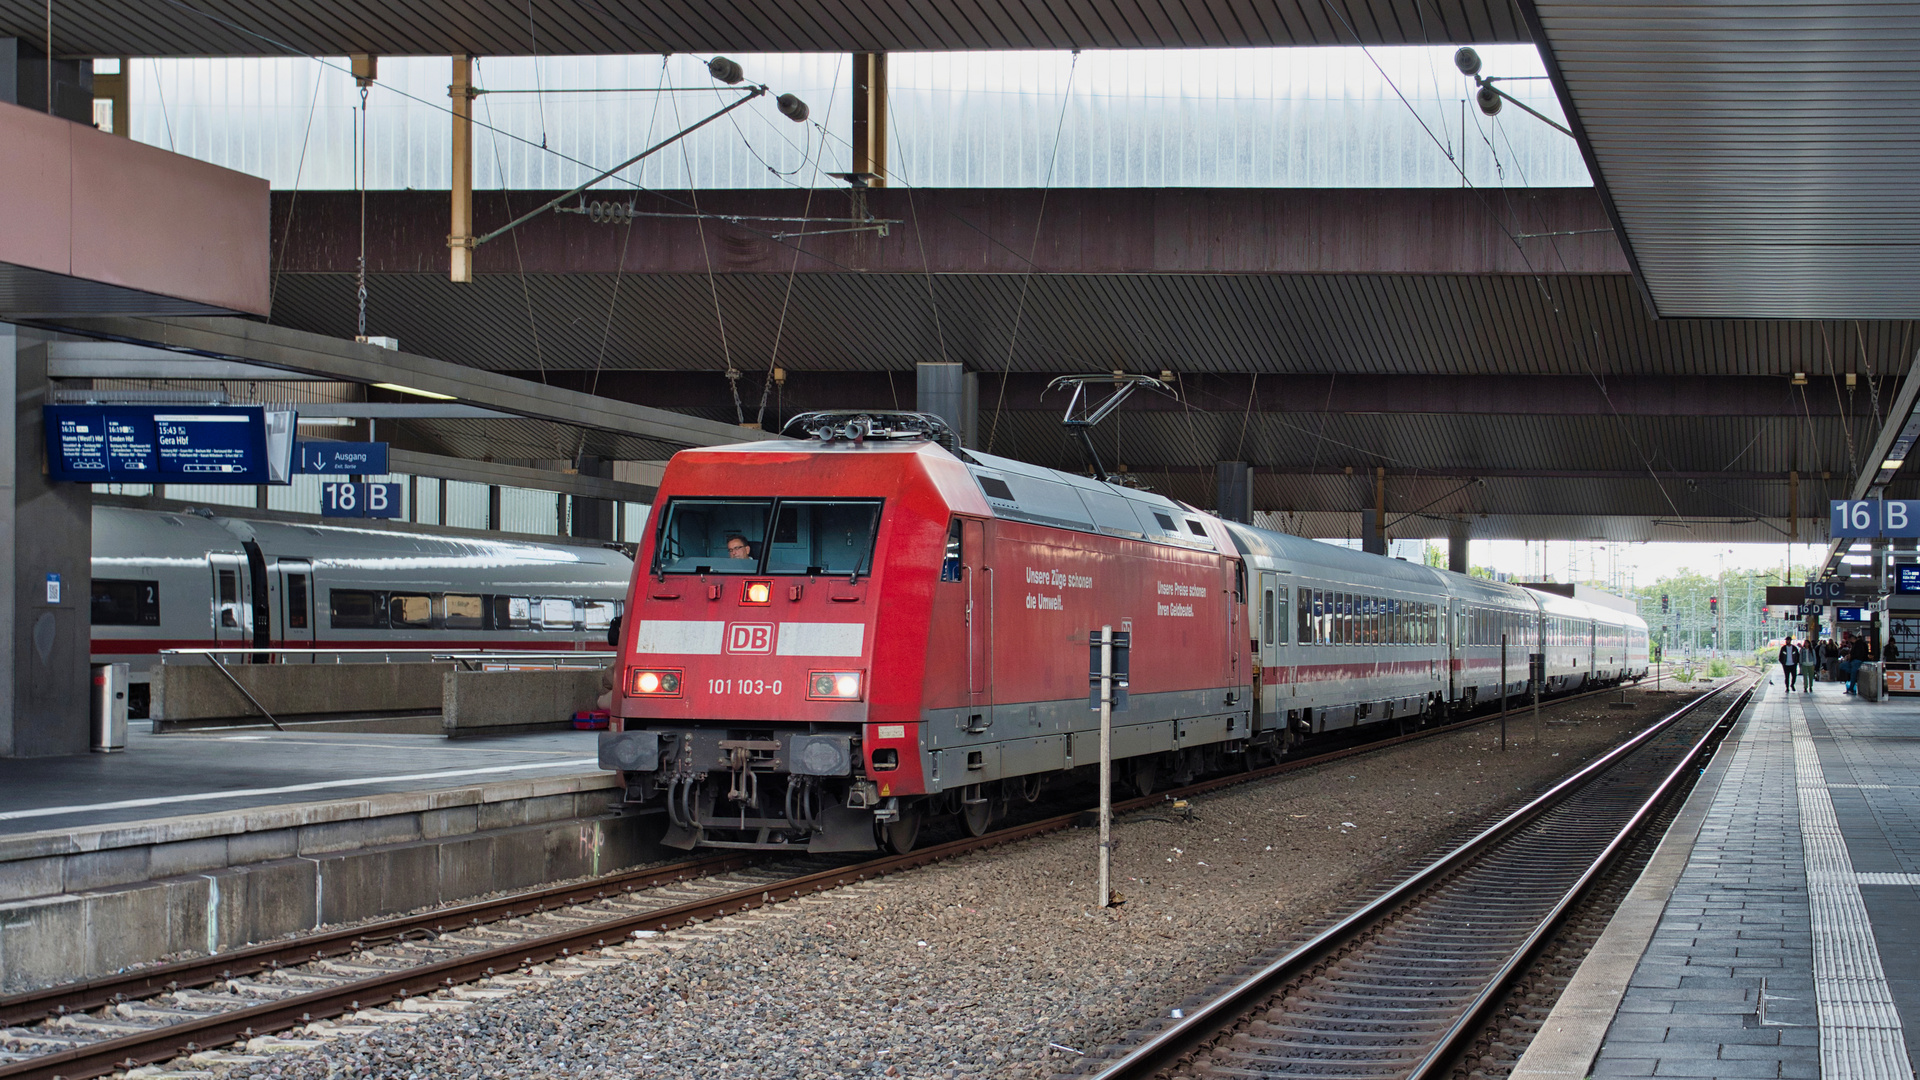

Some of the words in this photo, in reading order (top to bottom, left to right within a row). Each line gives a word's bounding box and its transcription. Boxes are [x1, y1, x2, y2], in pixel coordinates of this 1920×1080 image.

[159, 426, 177, 435] 15:43
[160, 436, 176, 445] Gera
[176, 435, 189, 445] Hbf
[334, 452, 367, 462] Ausgang
[326, 483, 356, 510] 18
[370, 484, 388, 510] B
[1836, 501, 1870, 530] 16
[1887, 501, 1908, 529] B
[1026, 566, 1050, 585] Unsere
[1051, 569, 1067, 590] Züge
[1068, 572, 1092, 589] schonen
[146, 586, 154, 604] 2
[1157, 580, 1173, 595] Unsere
[1174, 581, 1188, 596] Preise
[1189, 583, 1206, 598] schonen
[1806, 583, 1823, 596] 16
[1829, 583, 1840, 596] C
[380, 595, 386, 610] 2
[1026, 592, 1036, 609] die
[1038, 593, 1063, 610] Umwelt.
[1157, 601, 1169, 616] Ihren
[1799, 605, 1809, 613] 16
[1813, 605, 1820, 613] D
[733, 627, 768, 649] DB
[708, 679, 732, 695] 101
[738, 679, 782, 695] 103-0
